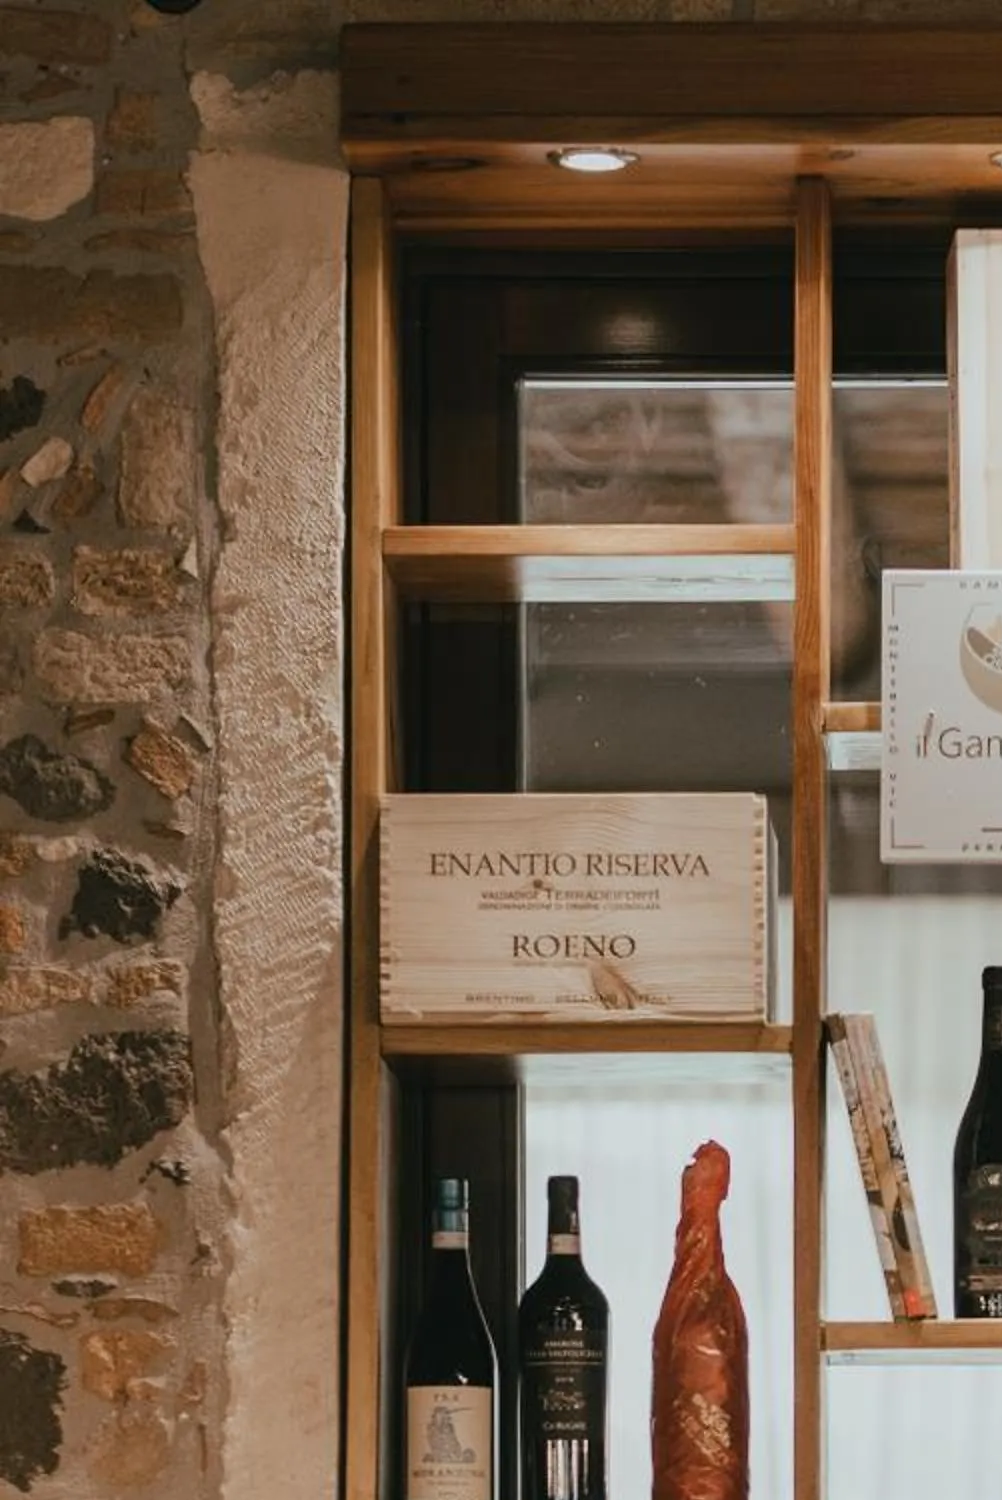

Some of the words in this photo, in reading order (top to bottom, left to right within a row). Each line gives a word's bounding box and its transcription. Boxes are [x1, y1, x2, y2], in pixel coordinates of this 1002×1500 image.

[429, 852, 577, 878] ENANTIO
[585, 852, 711, 877] RISERVA
[512, 933, 637, 960] ROENO
